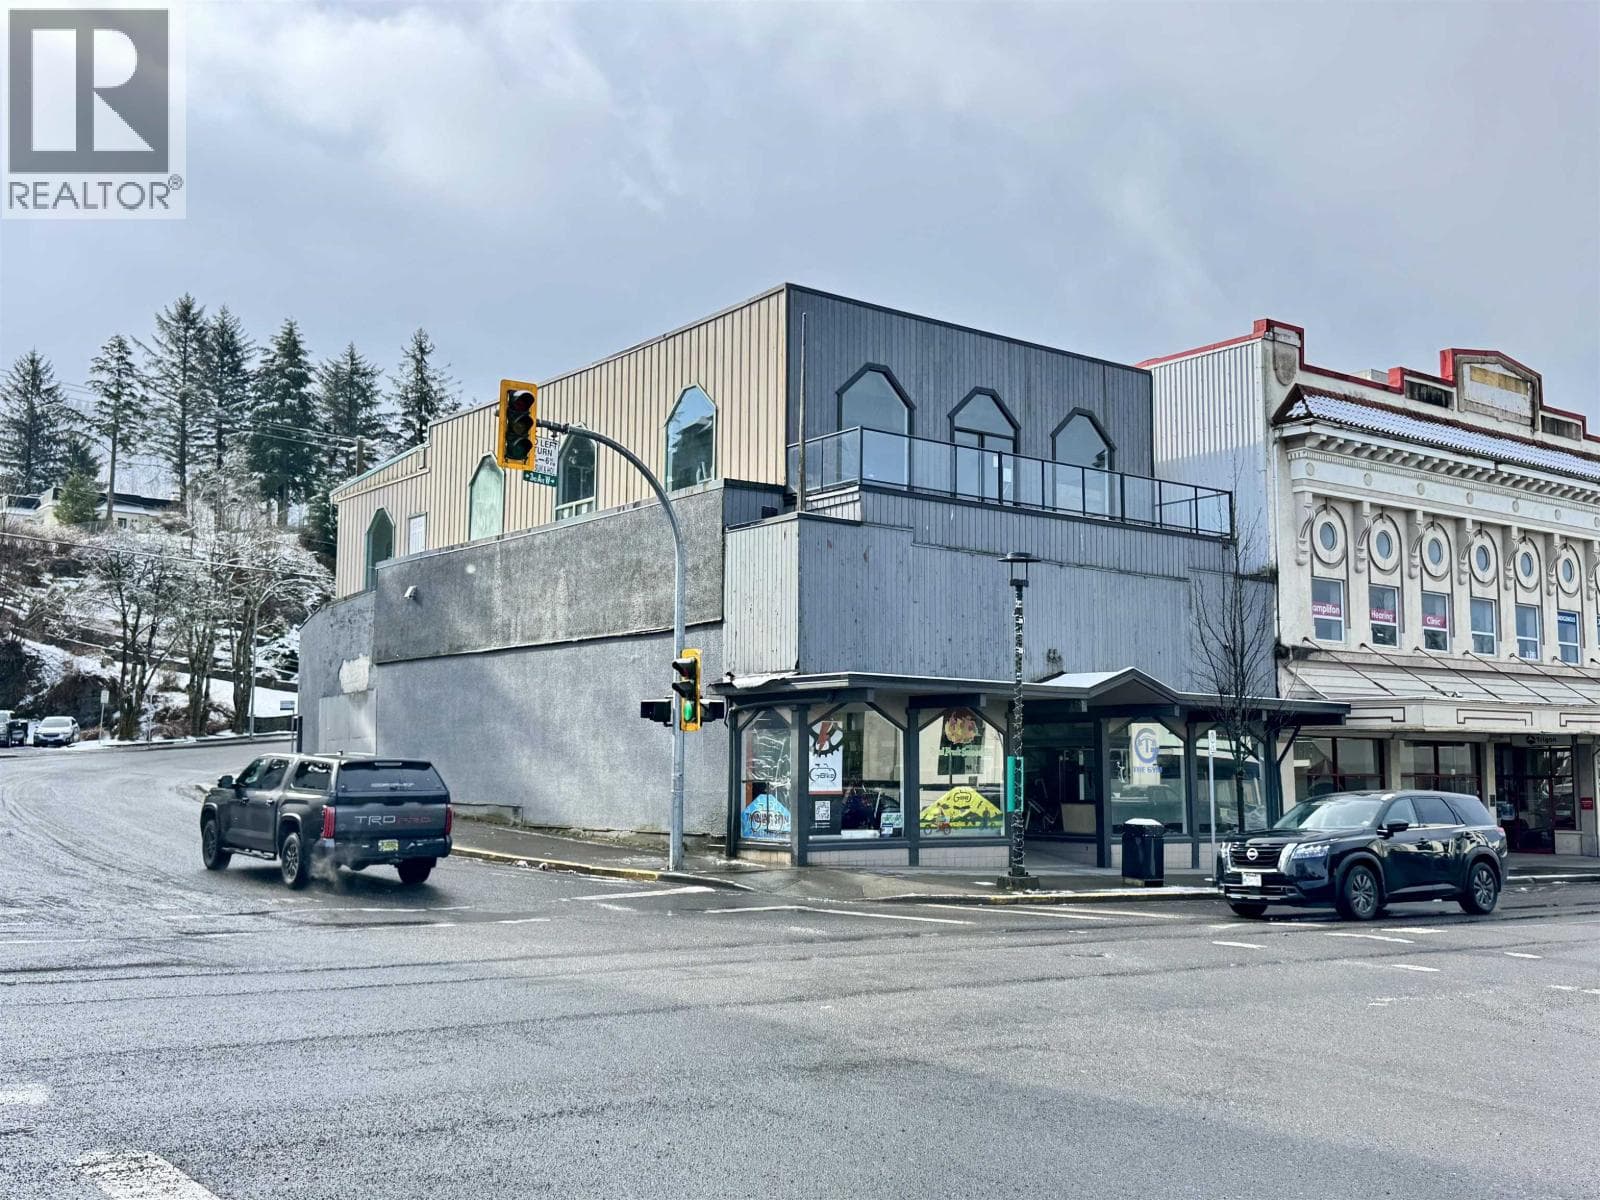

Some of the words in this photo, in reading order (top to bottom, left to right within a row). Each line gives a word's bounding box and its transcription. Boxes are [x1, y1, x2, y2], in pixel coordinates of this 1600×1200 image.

[540, 440, 557, 449] LEFT
[537, 447, 553, 457] URN
[1312, 604, 1340, 614] amplifon
[1371, 611, 1393, 622] Hearing
[1426, 616, 1441, 626] Clinic
